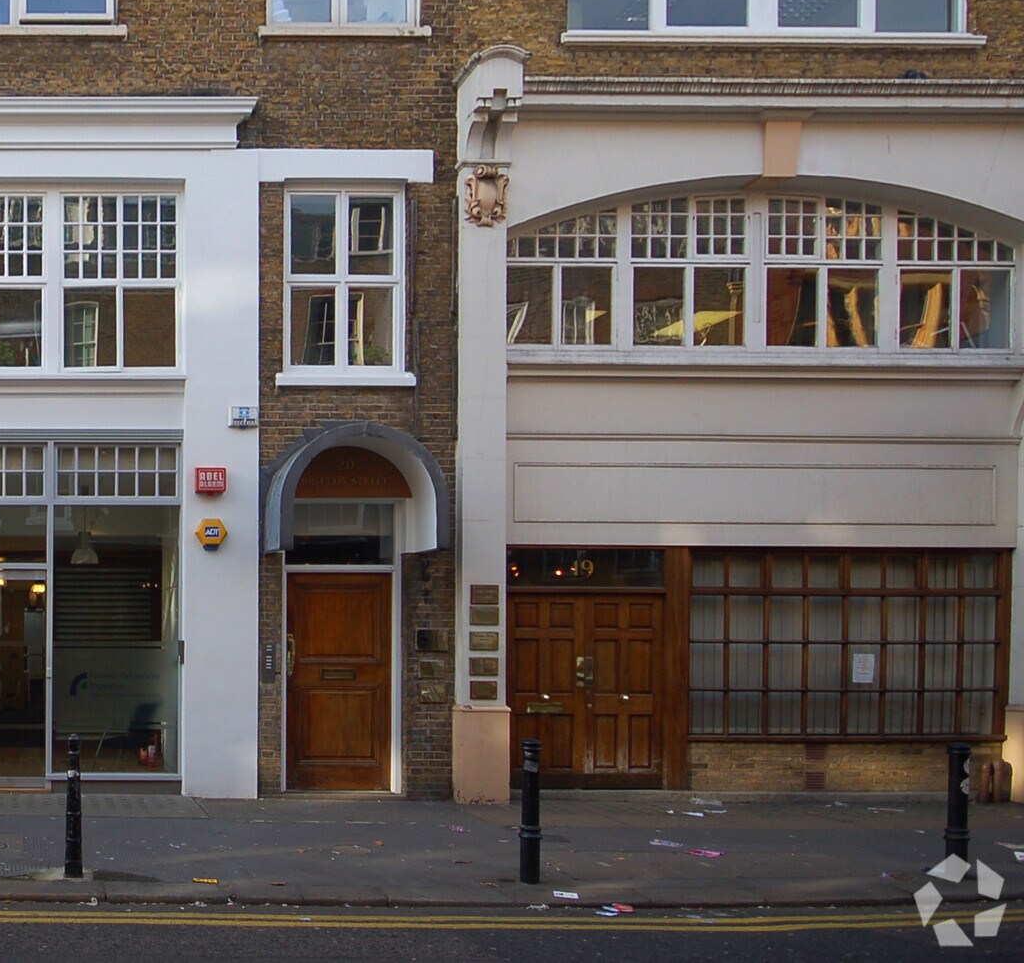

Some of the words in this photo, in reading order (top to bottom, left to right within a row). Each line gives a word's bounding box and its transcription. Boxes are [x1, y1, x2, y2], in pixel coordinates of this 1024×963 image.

[199, 471, 224, 481] ABEL
[205, 528, 219, 536] ADT
[573, 559, 594, 577] 19
